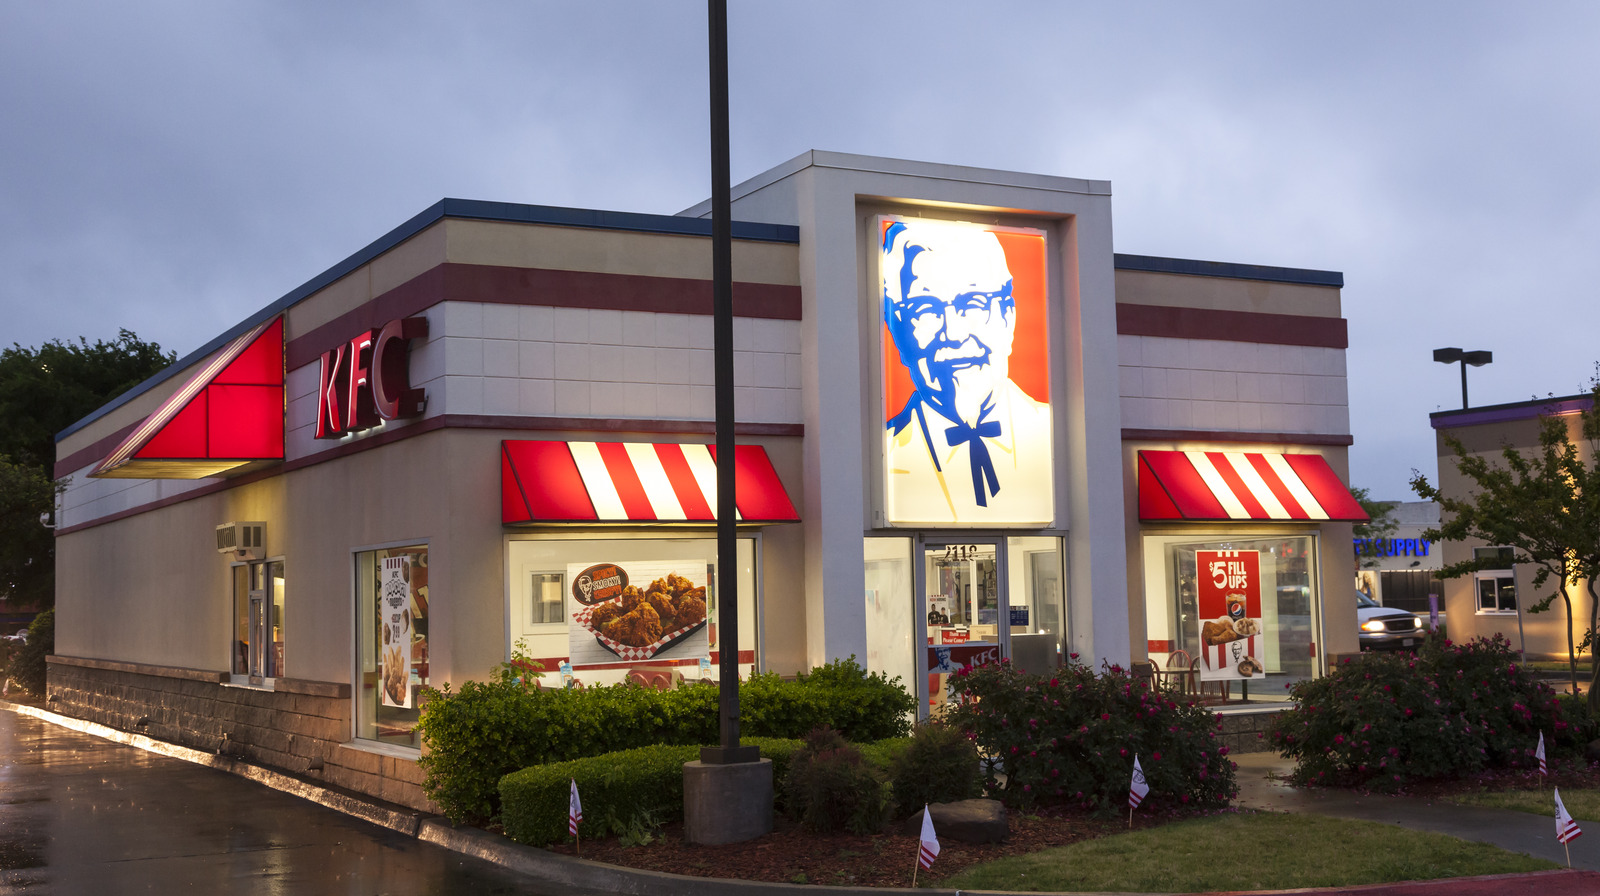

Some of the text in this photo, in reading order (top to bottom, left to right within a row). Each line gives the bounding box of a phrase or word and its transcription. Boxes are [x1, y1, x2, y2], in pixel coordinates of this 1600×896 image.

[314, 317, 426, 439] KFC
[1375, 537, 1431, 557] SUPPLY
[592, 575, 621, 590] SMOKY!
[1208, 561, 1247, 589] $5 FILL
[1228, 575, 1248, 589] UPS
[970, 648, 997, 668] KFC
